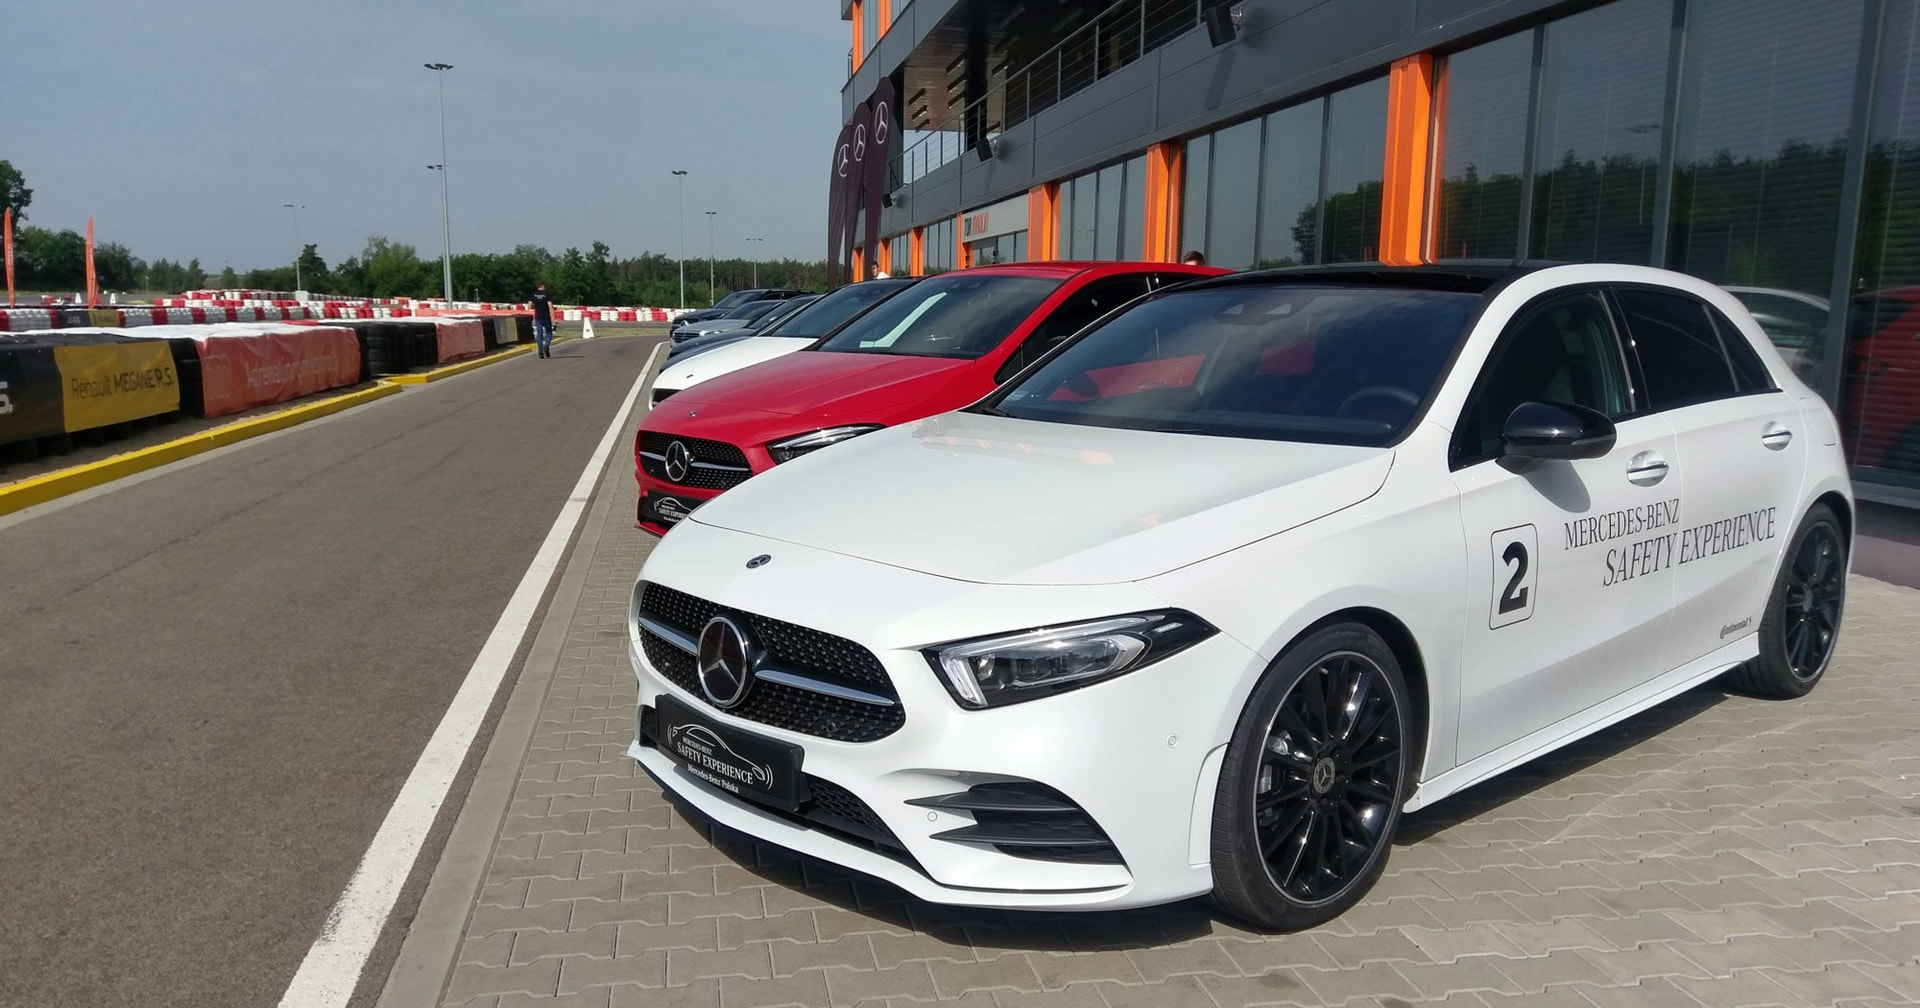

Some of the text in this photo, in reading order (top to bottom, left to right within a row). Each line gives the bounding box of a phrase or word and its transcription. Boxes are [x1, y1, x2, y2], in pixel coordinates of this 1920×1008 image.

[71, 377, 112, 399] Renault
[113, 368, 155, 393] MEGANE
[1564, 498, 1680, 550] MERCEDES-BENZ
[1603, 506, 1776, 587] SAFETY EXPERIENCE
[1498, 541, 1529, 615] 2
[677, 741, 754, 785] SAFETY EXPERIENCE
[682, 736, 713, 756] MERCEDES-BENZ
[687, 763, 740, 794] Mercedes-Benz Polska
